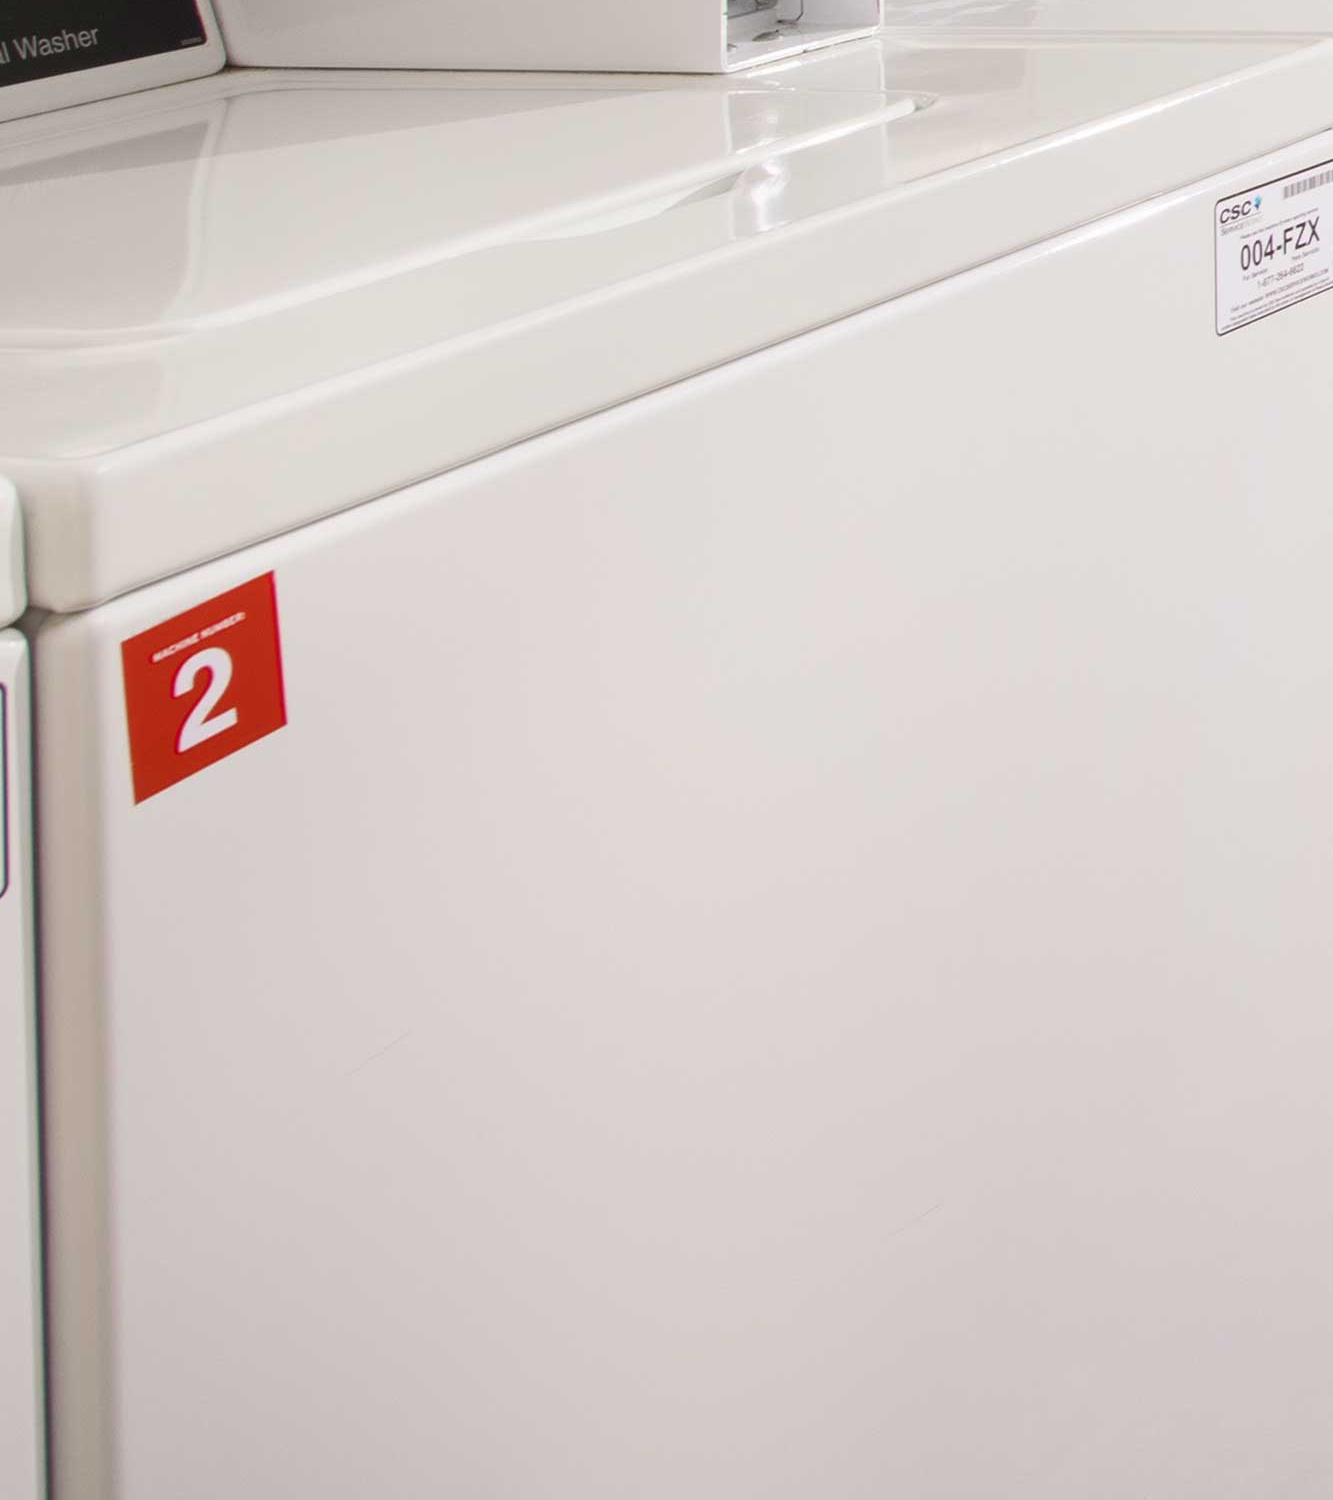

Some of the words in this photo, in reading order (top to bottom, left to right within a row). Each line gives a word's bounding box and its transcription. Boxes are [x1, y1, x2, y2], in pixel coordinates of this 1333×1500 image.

[14, 28, 99, 61] Washer
[1220, 200, 1252, 224] CSC
[1240, 216, 1320, 271] 004-FZX
[174, 646, 239, 754] 2
